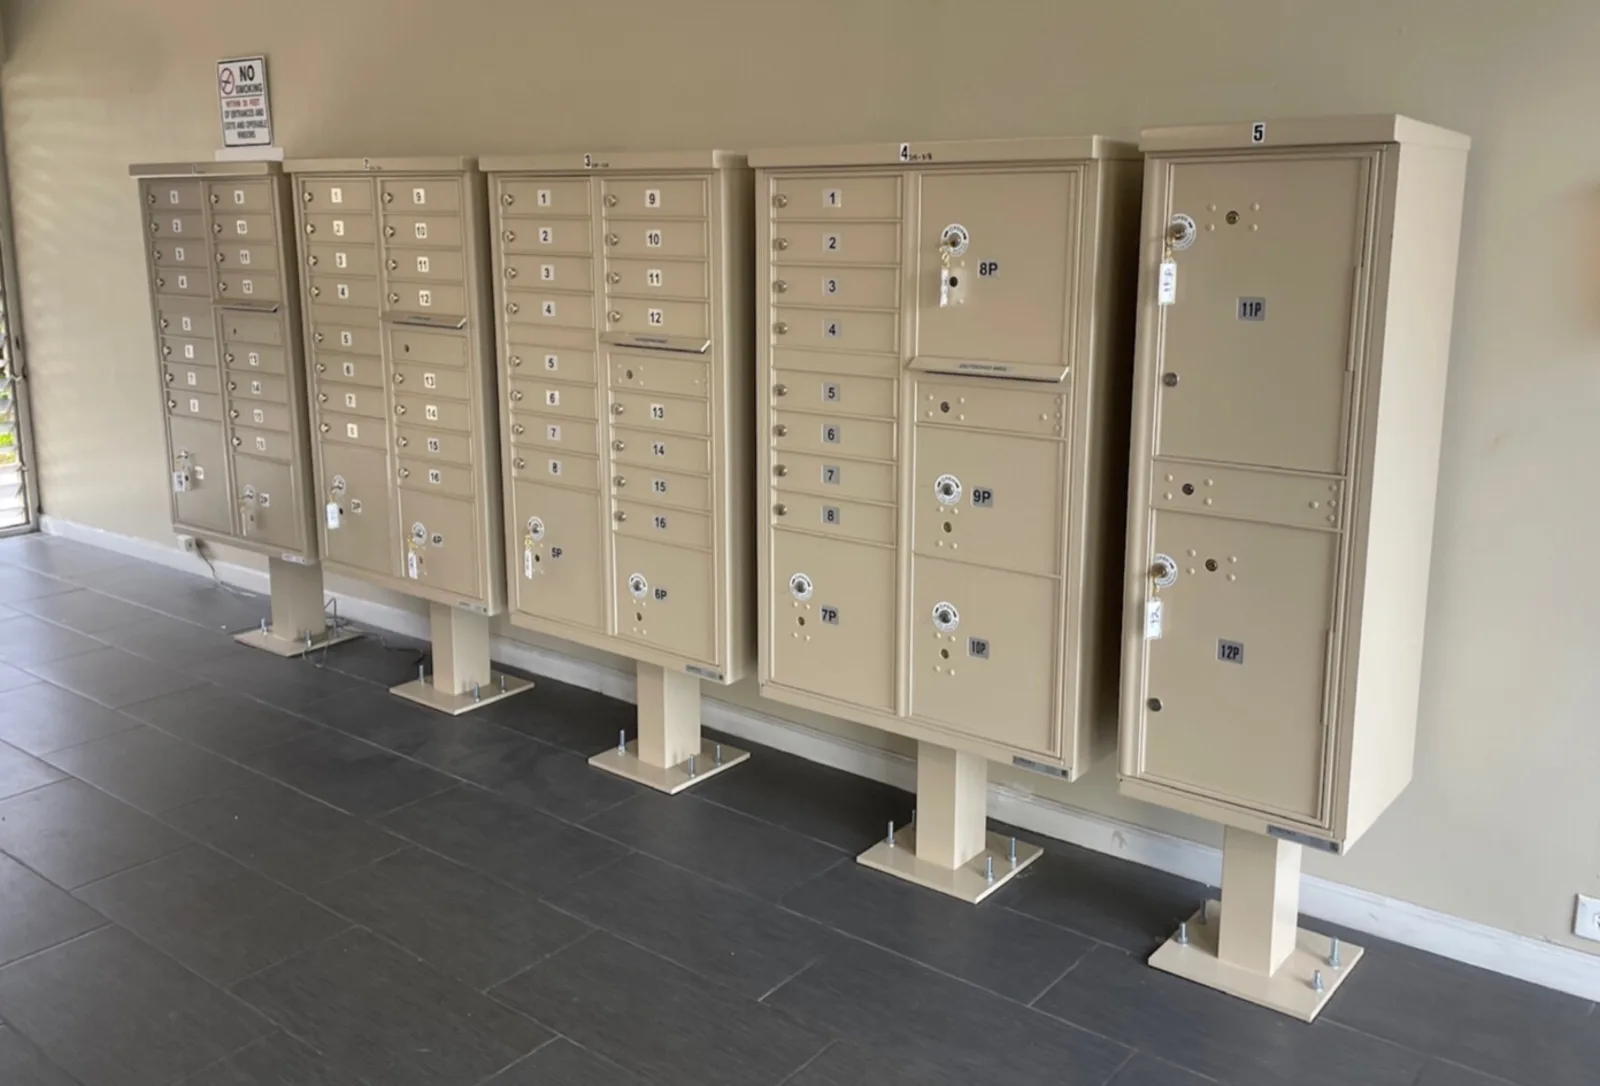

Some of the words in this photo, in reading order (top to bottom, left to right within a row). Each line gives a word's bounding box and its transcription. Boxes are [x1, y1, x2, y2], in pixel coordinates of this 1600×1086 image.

[239, 65, 255, 82] NO
[236, 83, 262, 94] SMOKING
[1253, 124, 1263, 141] 5
[901, 145, 908, 159] 4
[584, 154, 591, 168] 3
[541, 193, 546, 204] 1
[648, 193, 656, 205] 9
[829, 192, 835, 204] 1
[542, 230, 548, 242] 2
[648, 233, 660, 245] 10
[829, 236, 836, 250] 2
[544, 267, 550, 279] 3
[979, 262, 998, 276] 8P
[649, 273, 659, 283] 11
[829, 280, 836, 293] 3
[545, 304, 552, 314] 4
[1242, 302, 1262, 317] 11P
[650, 312, 661, 324] 12
[828, 324, 836, 335] 4
[548, 357, 554, 369] 5
[549, 393, 555, 404] 6
[828, 387, 835, 399] 5
[653, 407, 664, 419] 13
[551, 427, 556, 437] 7
[827, 428, 835, 441] 6
[653, 444, 665, 455] 14
[552, 462, 558, 473] 8
[827, 469, 834, 481] 7
[655, 481, 666, 492] 15
[973, 489, 991, 503] 9P
[827, 509, 834, 522] 8
[655, 517, 666, 529] 16
[551, 547, 562, 558] 5P
[655, 588, 667, 600] 6P
[822, 608, 837, 622] 7P
[971, 640, 986, 654] 10P
[1221, 644, 1240, 660] 12P
